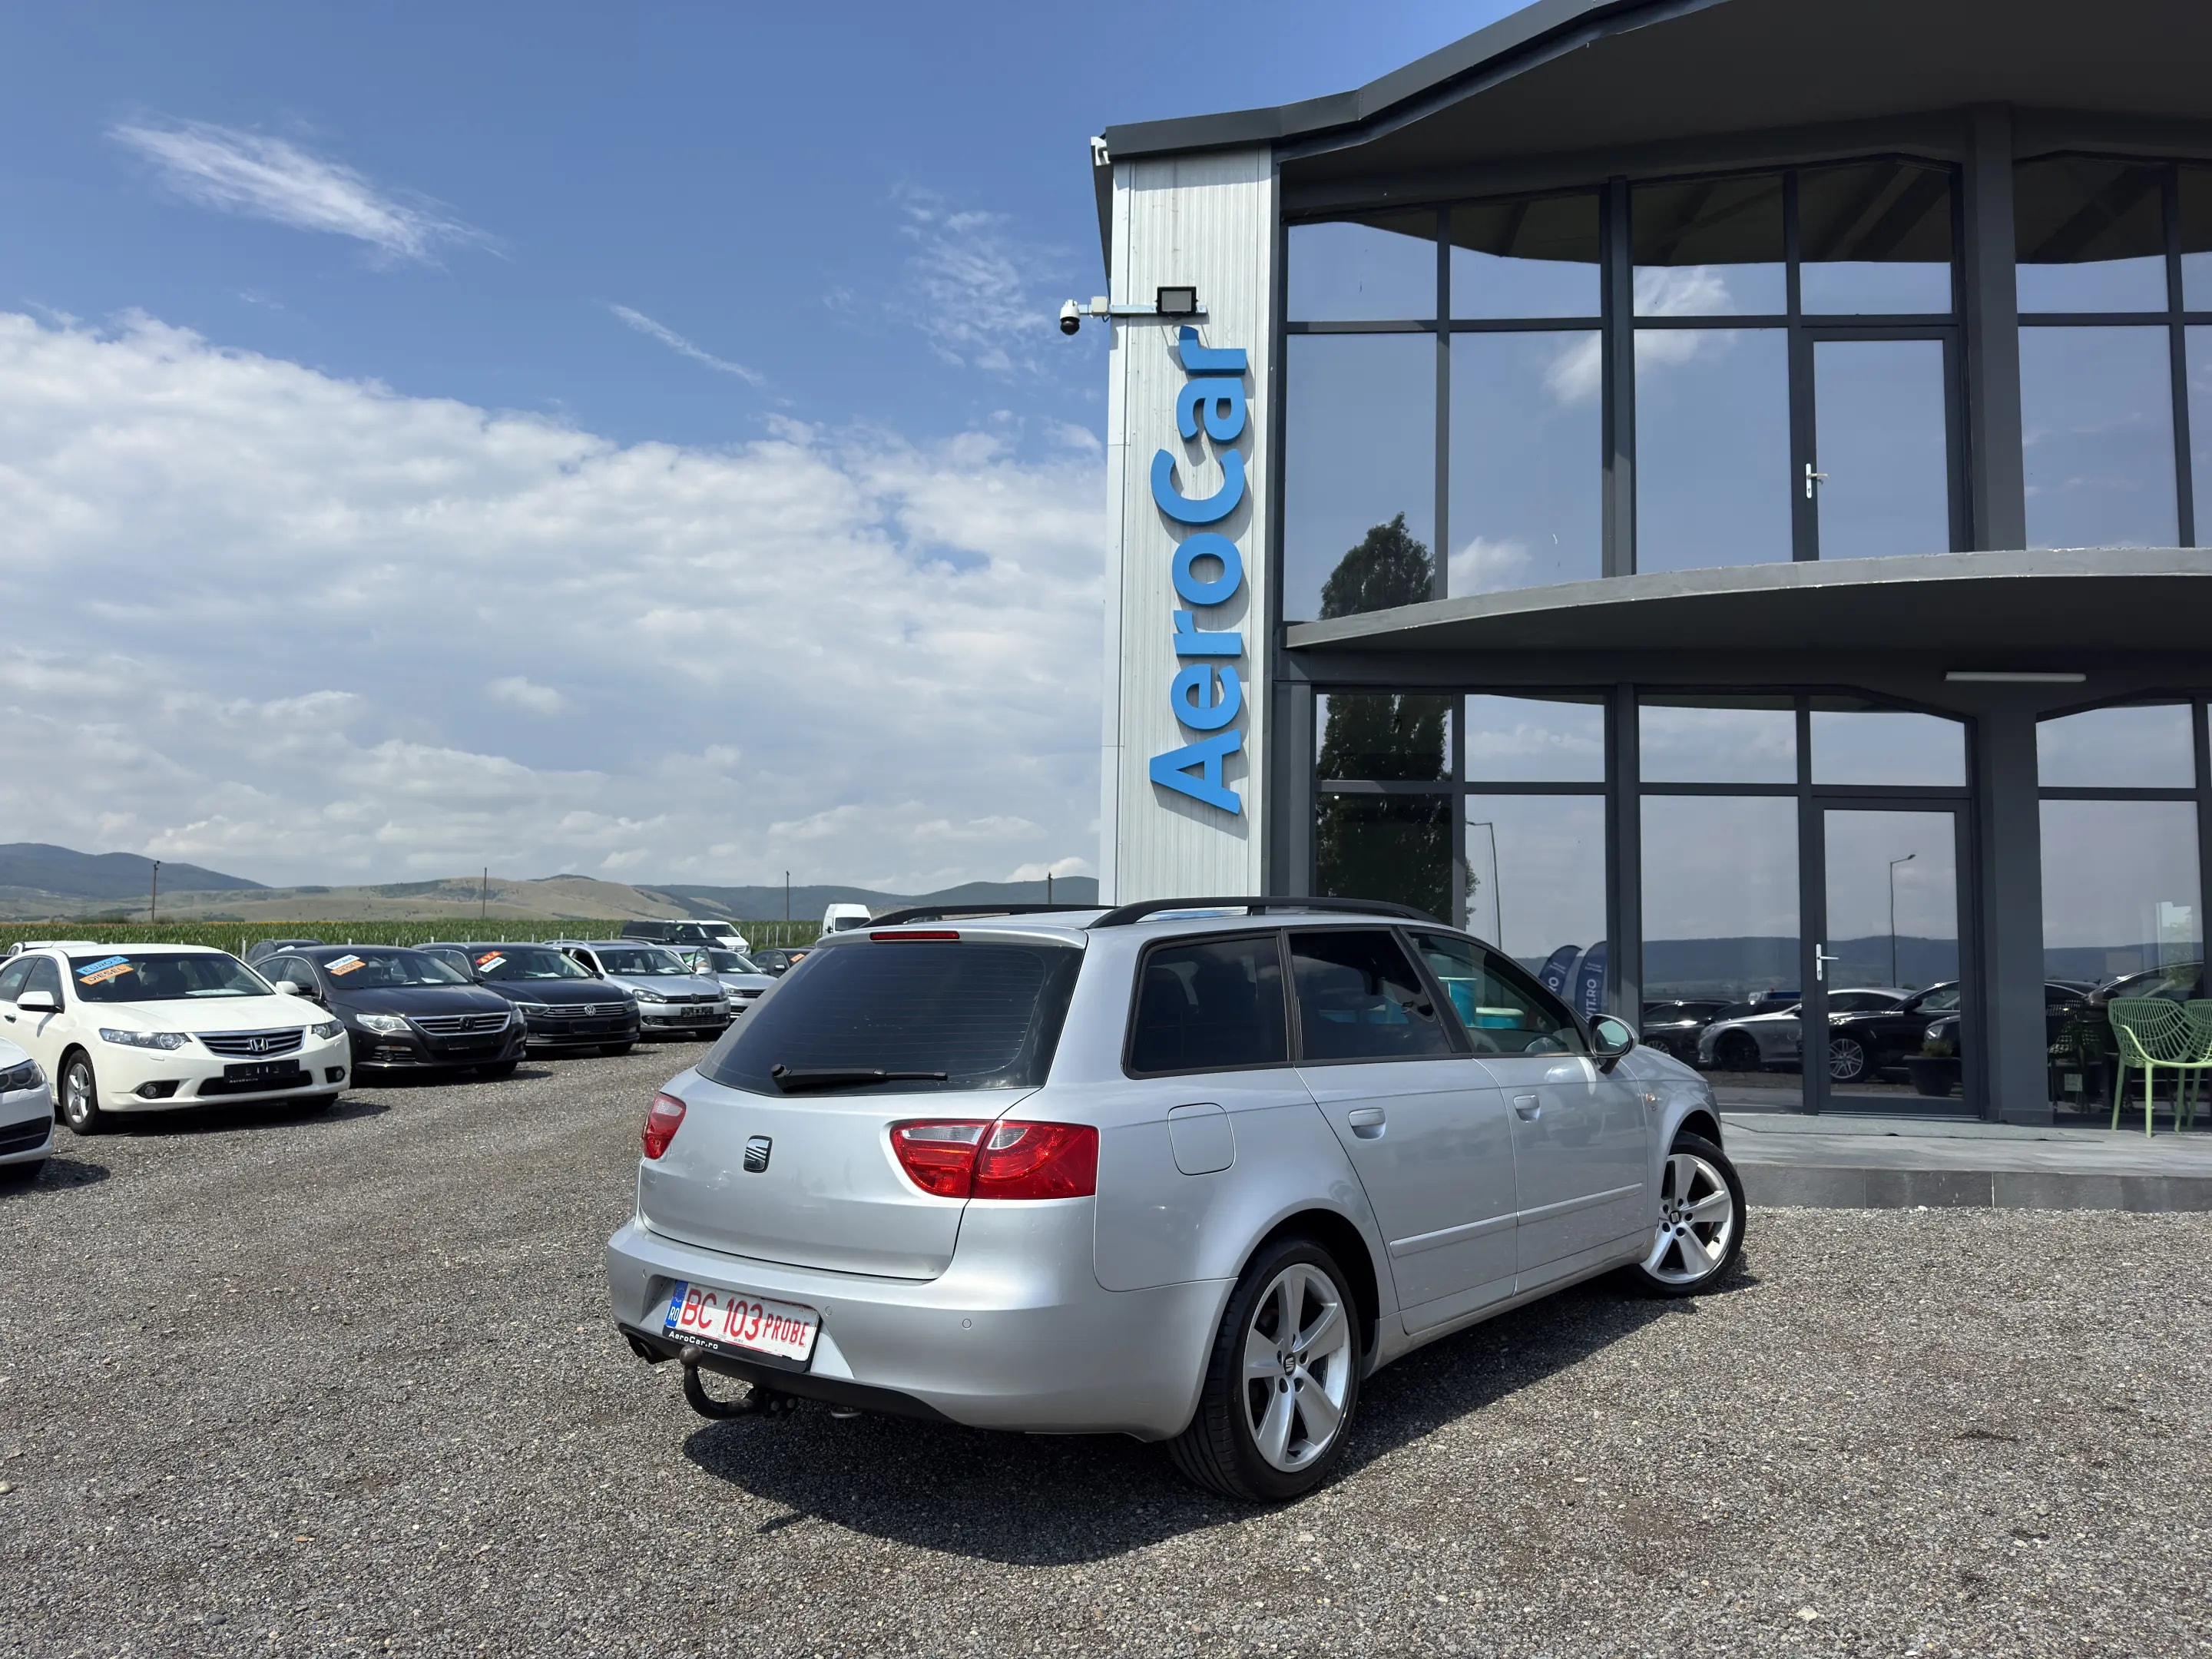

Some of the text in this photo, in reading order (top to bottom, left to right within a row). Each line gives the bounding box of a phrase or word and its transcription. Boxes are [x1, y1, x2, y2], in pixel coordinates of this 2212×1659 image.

[1149, 326, 1247, 815] AeroCar
[88, 968, 126, 982] DIESEL
[667, 1306, 680, 1322] RO
[680, 1288, 810, 1347] BC 103 PROBE
[668, 1330, 719, 1350] AeroCar.ro
